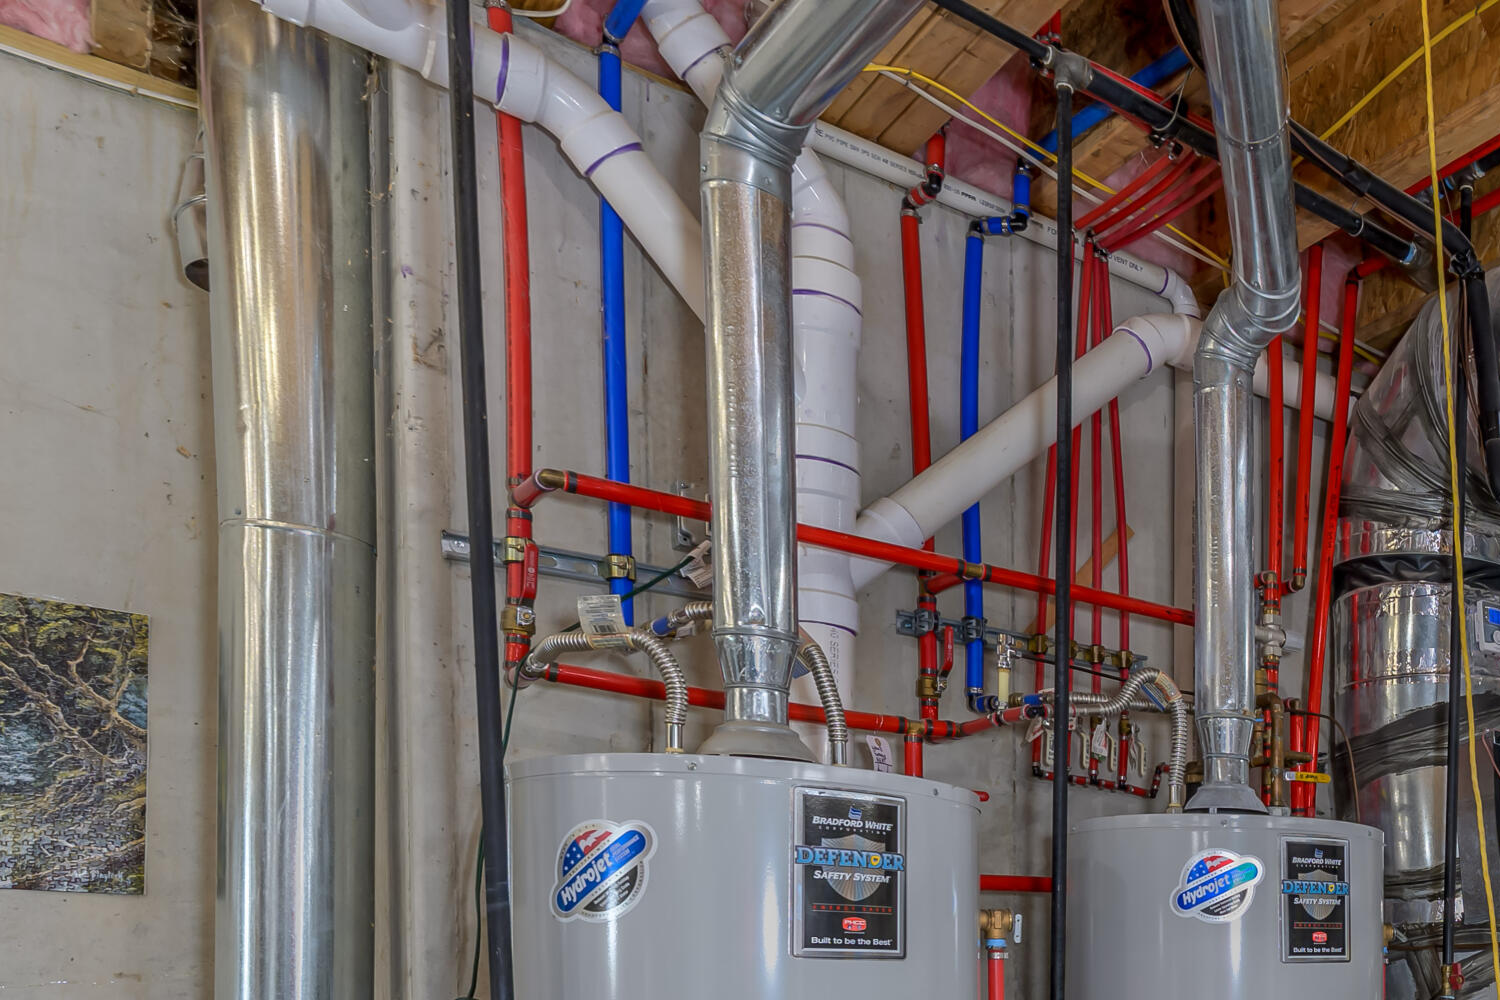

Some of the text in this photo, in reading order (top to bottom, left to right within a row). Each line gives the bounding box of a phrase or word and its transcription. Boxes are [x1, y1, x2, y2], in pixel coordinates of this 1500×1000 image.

[1113, 254, 1144, 272] VENT ONLY
[812, 816, 893, 831] BRADFORD WHITE
[795, 845, 904, 871] DEFENDER
[1292, 856, 1342, 866] BRADFORD WHITE
[561, 852, 613, 906] Hydrojet
[813, 870, 891, 883] SAFETY SYSTEM
[1182, 873, 1231, 906] Hydrojet
[1282, 880, 1349, 895] DEFENDER
[1294, 897, 1317, 905] SAFETY
[811, 936, 892, 946] Built to be the Best
